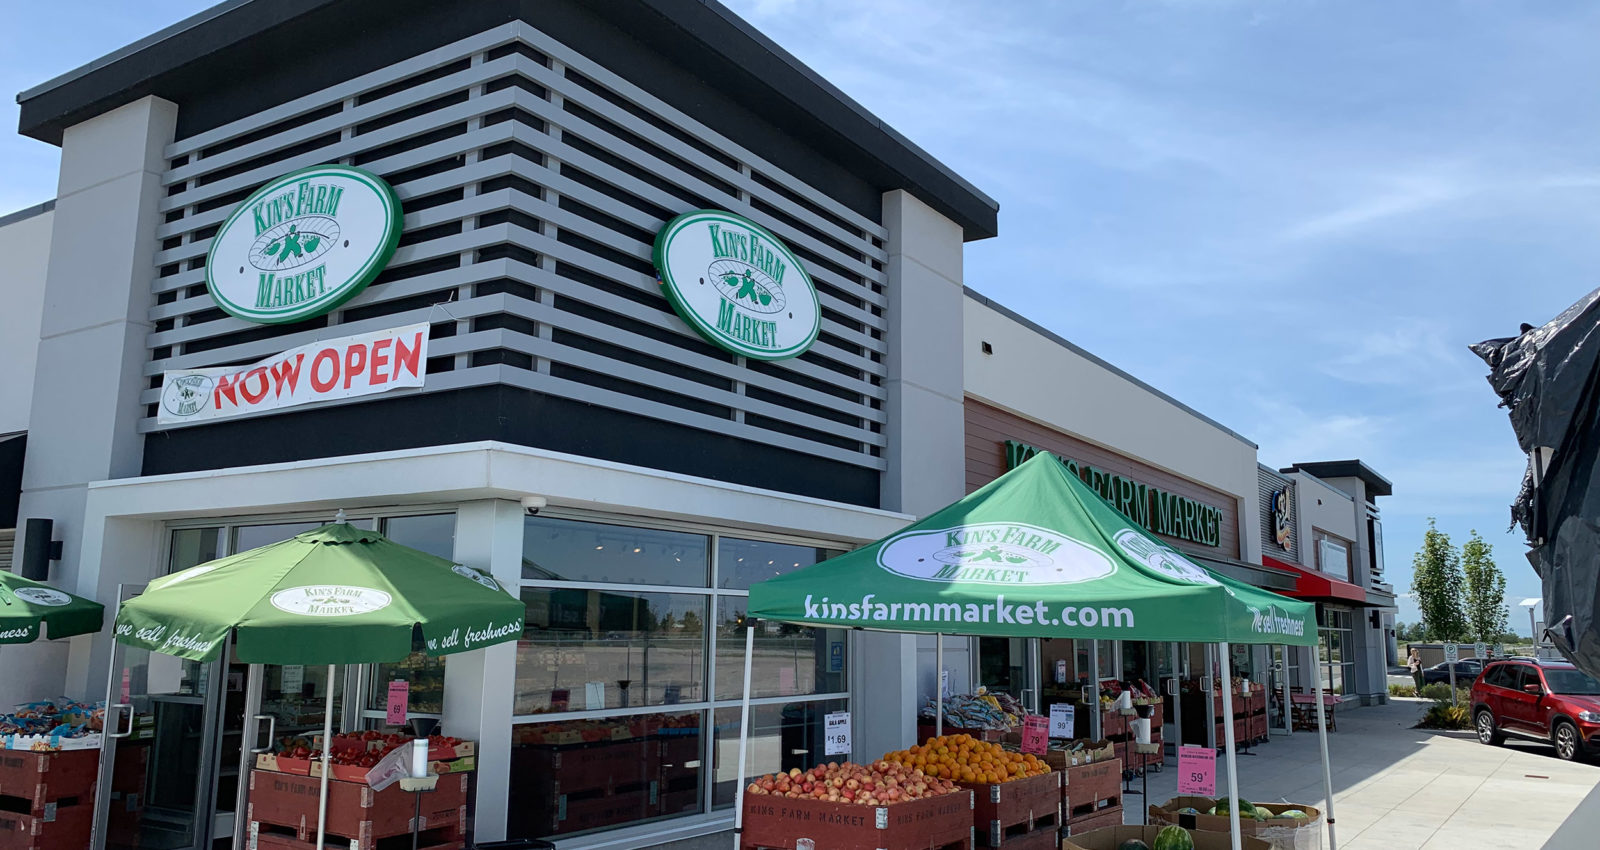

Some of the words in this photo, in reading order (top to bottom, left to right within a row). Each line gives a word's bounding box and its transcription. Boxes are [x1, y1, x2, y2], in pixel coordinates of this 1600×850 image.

[252, 189, 296, 238] KIN'S
[295, 178, 344, 217] FARM
[708, 223, 748, 261] KIN'S
[749, 233, 786, 286] FARM
[254, 264, 327, 308] MARKET
[716, 297, 777, 348] MARKET
[213, 353, 305, 409] NOW
[310, 332, 423, 393] OPEN
[1086, 466, 1152, 530] FARM
[1152, 488, 1224, 547] MARKET
[944, 528, 1000, 548] KIN'S
[1001, 526, 1062, 555] FARM
[931, 564, 1029, 583] MARKET
[333, 587, 362, 598] FARM
[307, 604, 355, 614] MARKET
[804, 594, 1135, 630] kinsfarmmarket.com
[136, 626, 166, 642] sell
[441, 628, 460, 648] sell
[781, 807, 811, 821] FARM
[819, 809, 865, 827] MARKET
